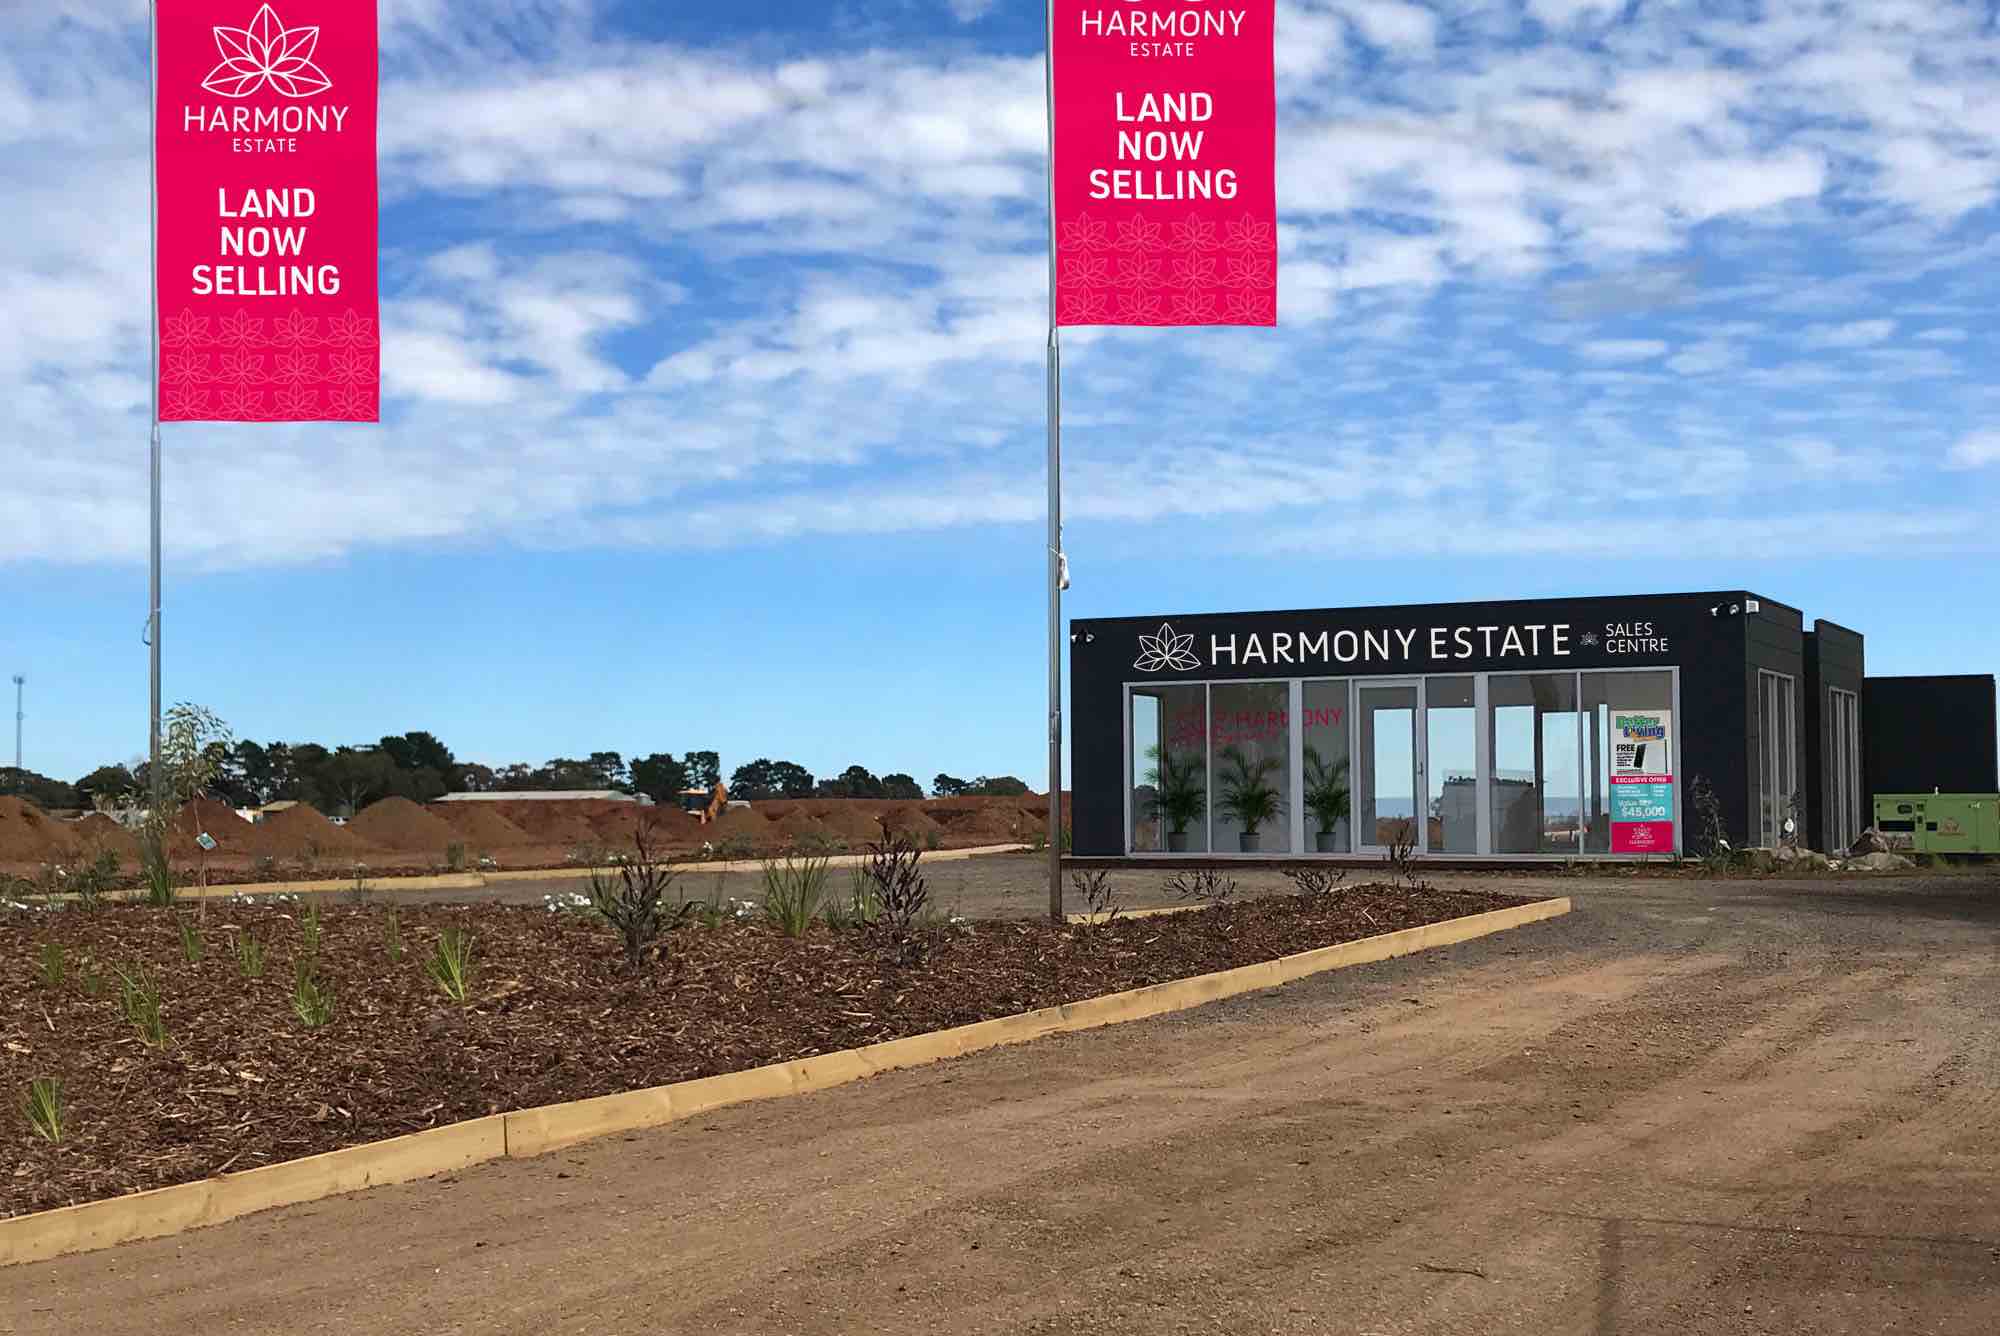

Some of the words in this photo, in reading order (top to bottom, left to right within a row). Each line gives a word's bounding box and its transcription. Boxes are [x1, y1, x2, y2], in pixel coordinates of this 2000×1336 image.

[1081, 10, 1246, 37] HARMONY
[1130, 42, 1194, 57] ESTATE
[184, 105, 349, 133] HARMONY
[1116, 92, 1213, 123] LAND
[233, 138, 297, 153] ESTATE
[1118, 130, 1204, 162] NOW
[1089, 168, 1237, 200] SELLING
[218, 187, 315, 218] LAND
[220, 226, 307, 257] NOW
[191, 264, 340, 296] SELLING
[1605, 621, 1653, 638] SALES
[1211, 628, 1417, 666] HARMONY
[1430, 623, 1571, 659] ESTATE
[1606, 637, 1669, 654] CENTRE
[1616, 744, 1635, 752] FREE
